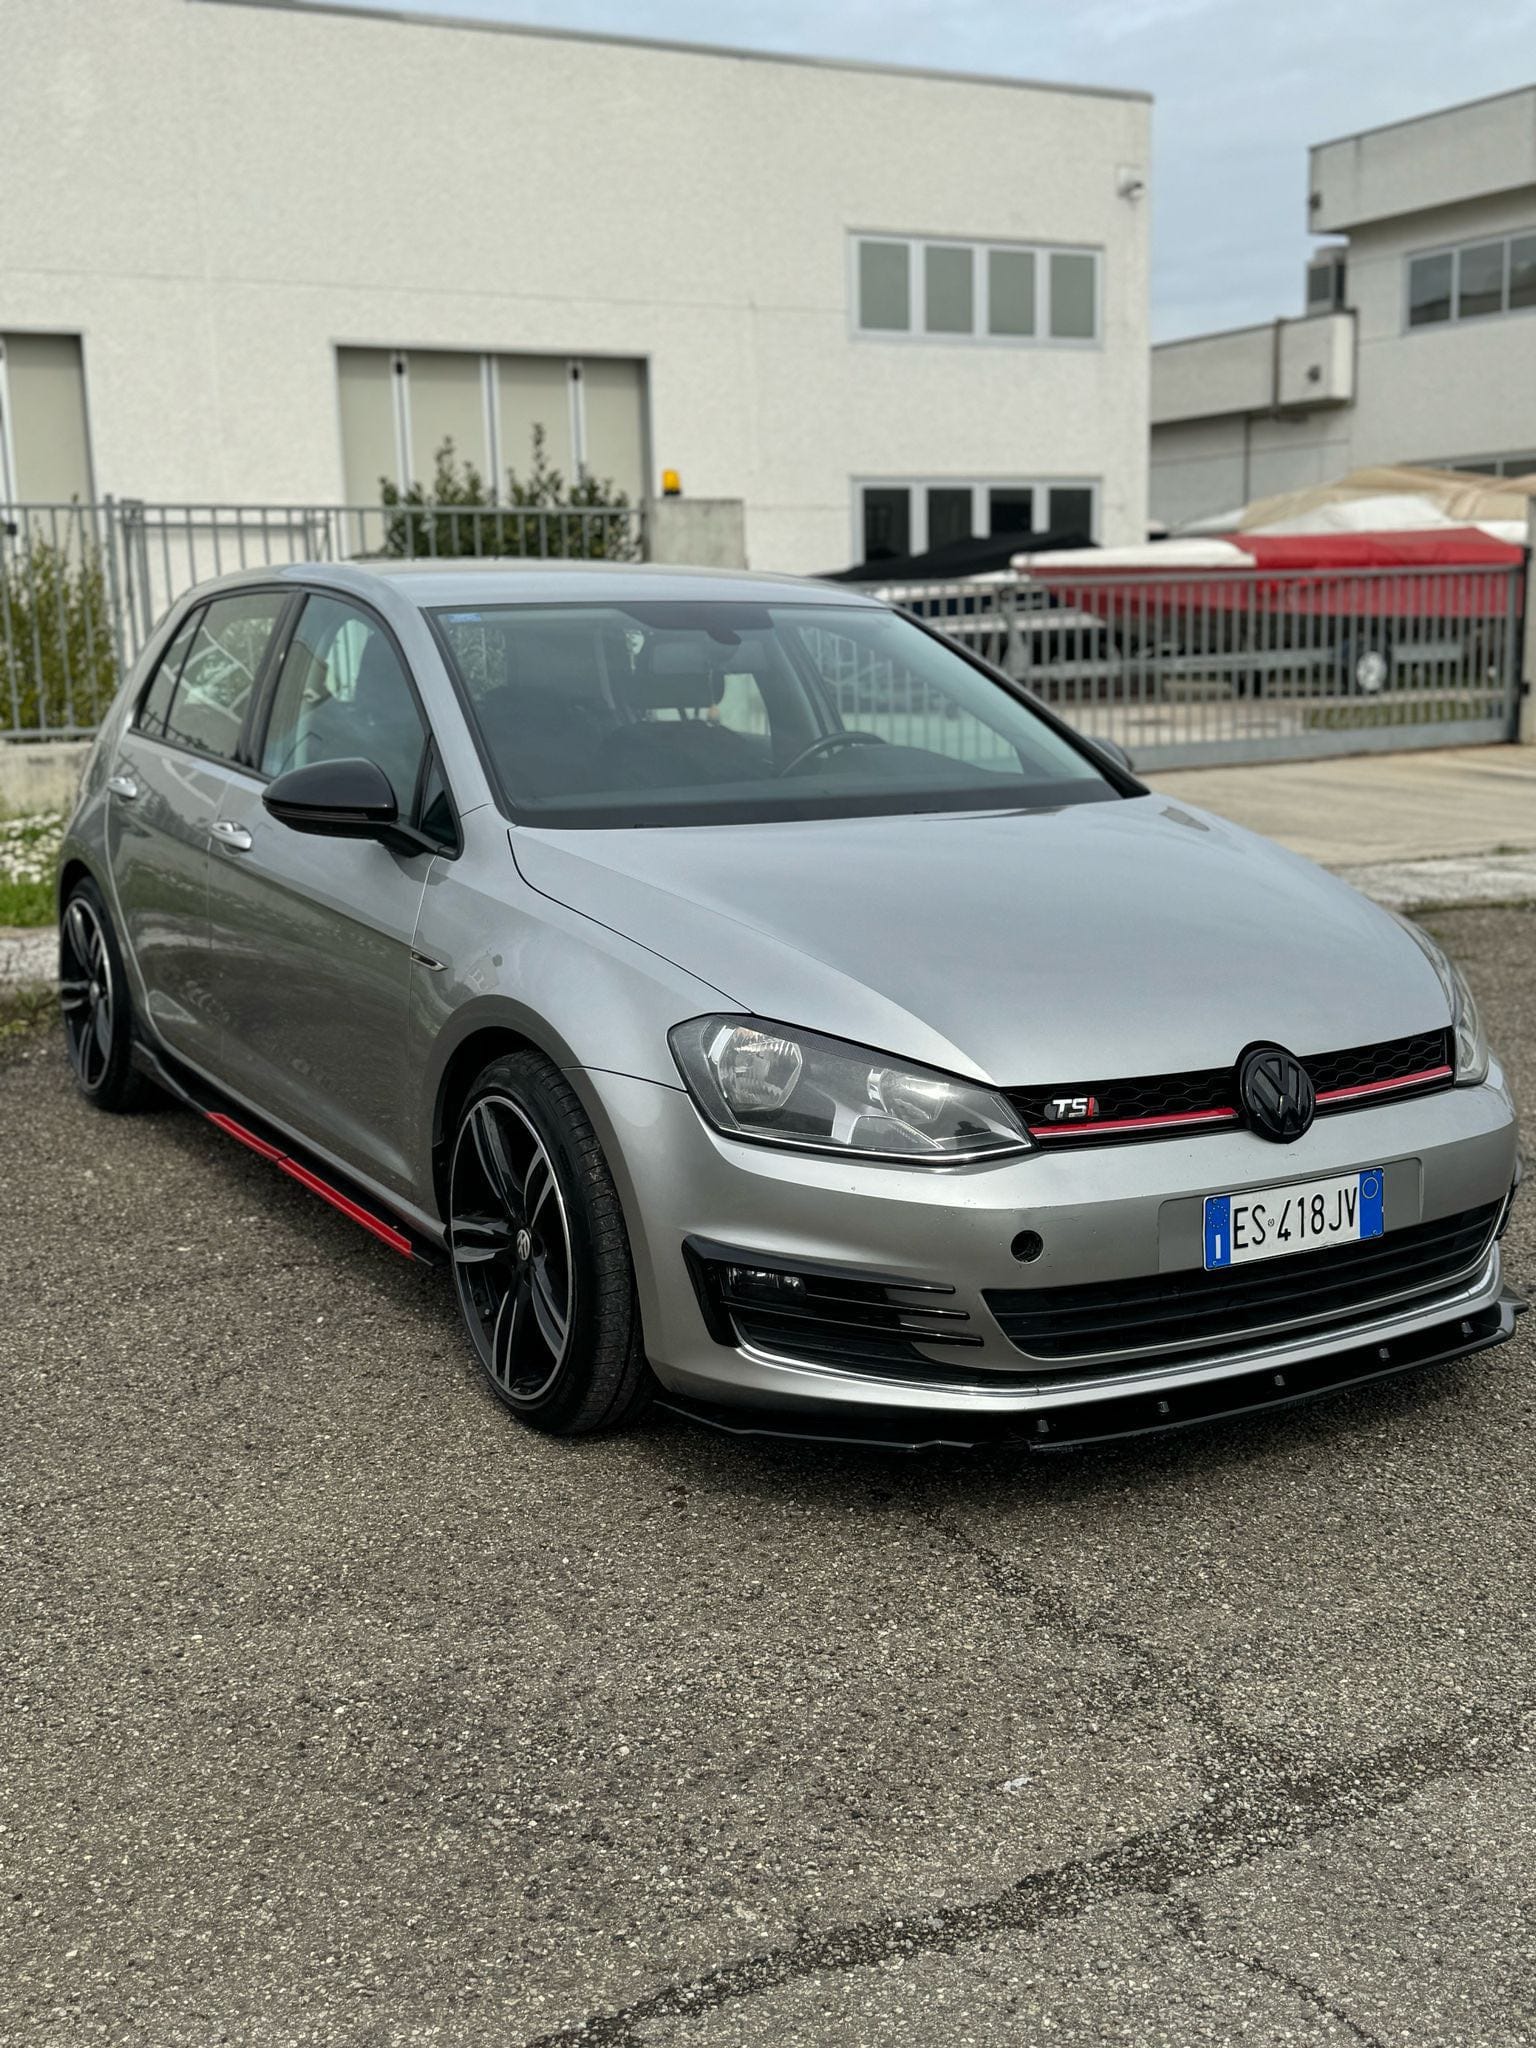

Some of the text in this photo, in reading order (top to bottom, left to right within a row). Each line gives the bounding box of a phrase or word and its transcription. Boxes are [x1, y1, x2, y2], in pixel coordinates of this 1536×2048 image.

[1233, 1187, 1358, 1250] ES 418JV
[1215, 1234, 1222, 1259] I
